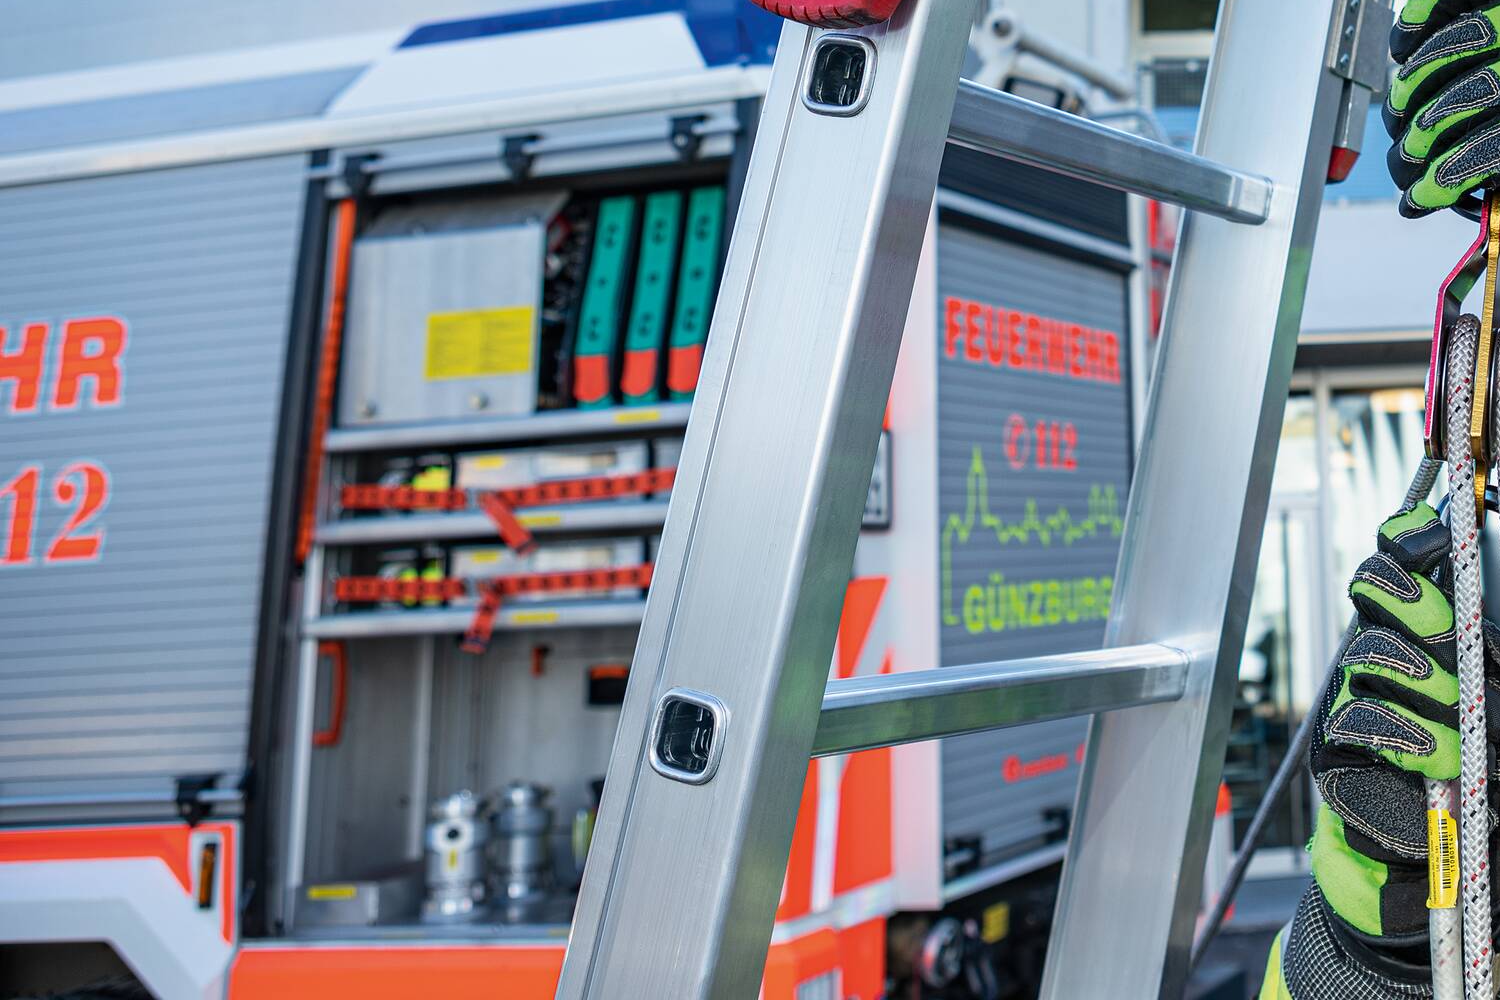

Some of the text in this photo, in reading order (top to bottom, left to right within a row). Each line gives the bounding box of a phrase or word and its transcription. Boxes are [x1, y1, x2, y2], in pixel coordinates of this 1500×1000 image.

[0, 315, 127, 412] HR
[944, 296, 1121, 384] FEUERWEHR
[1035, 419, 1078, 470] 112
[0, 462, 108, 565] 12
[964, 570, 1114, 634] GÜNZBURG
